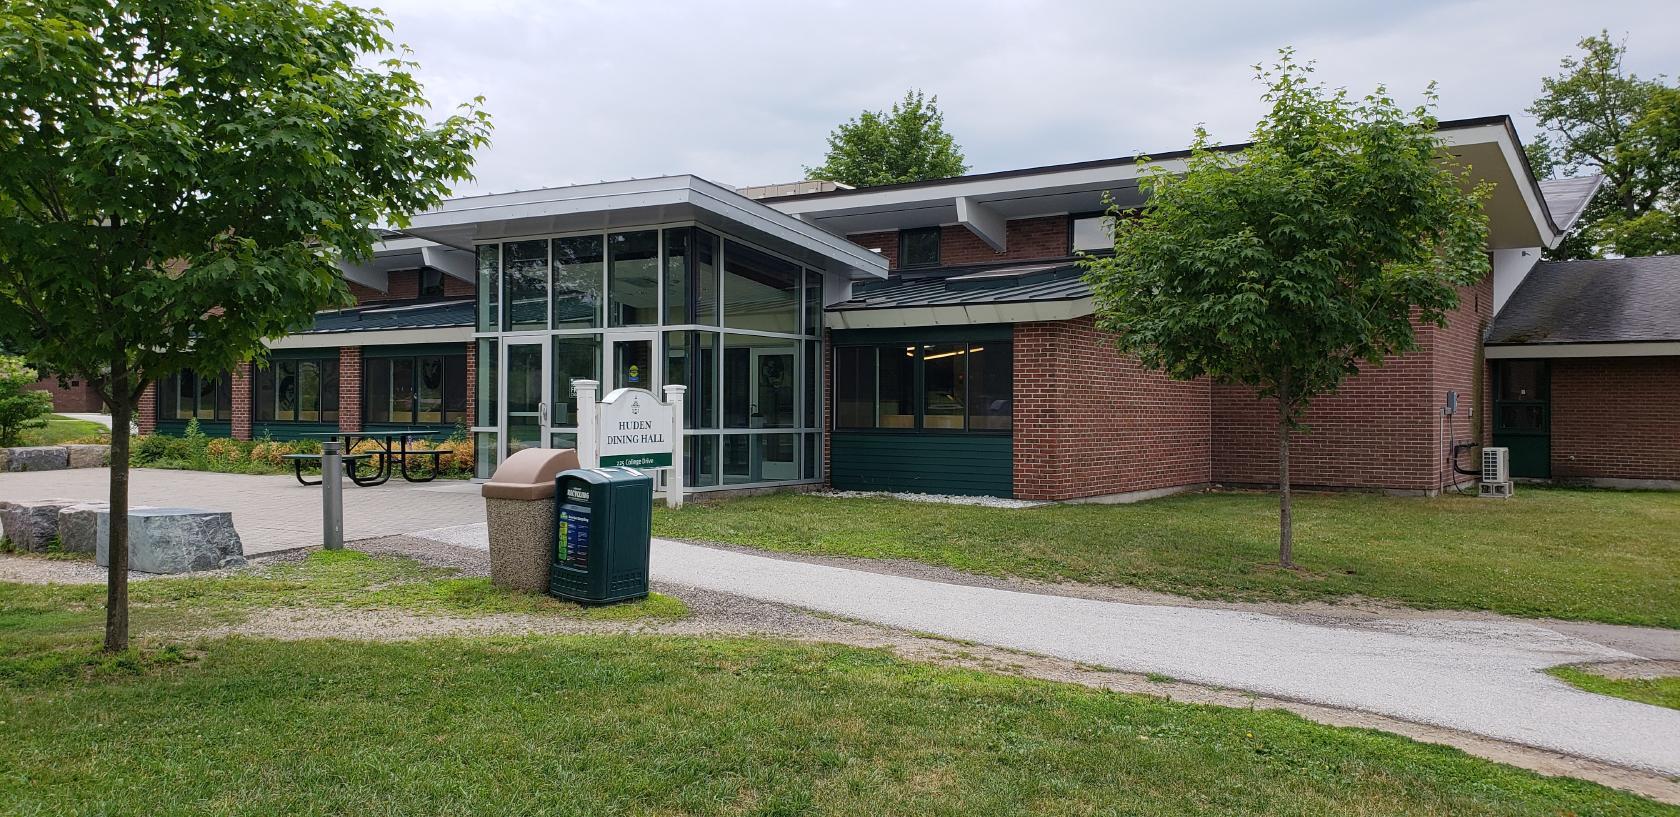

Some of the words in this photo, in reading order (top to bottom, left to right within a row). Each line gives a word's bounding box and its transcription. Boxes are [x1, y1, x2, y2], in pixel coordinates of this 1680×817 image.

[619, 421, 652, 430] HUDEN
[608, 435, 639, 445] DINING
[641, 434, 665, 443] HALL
